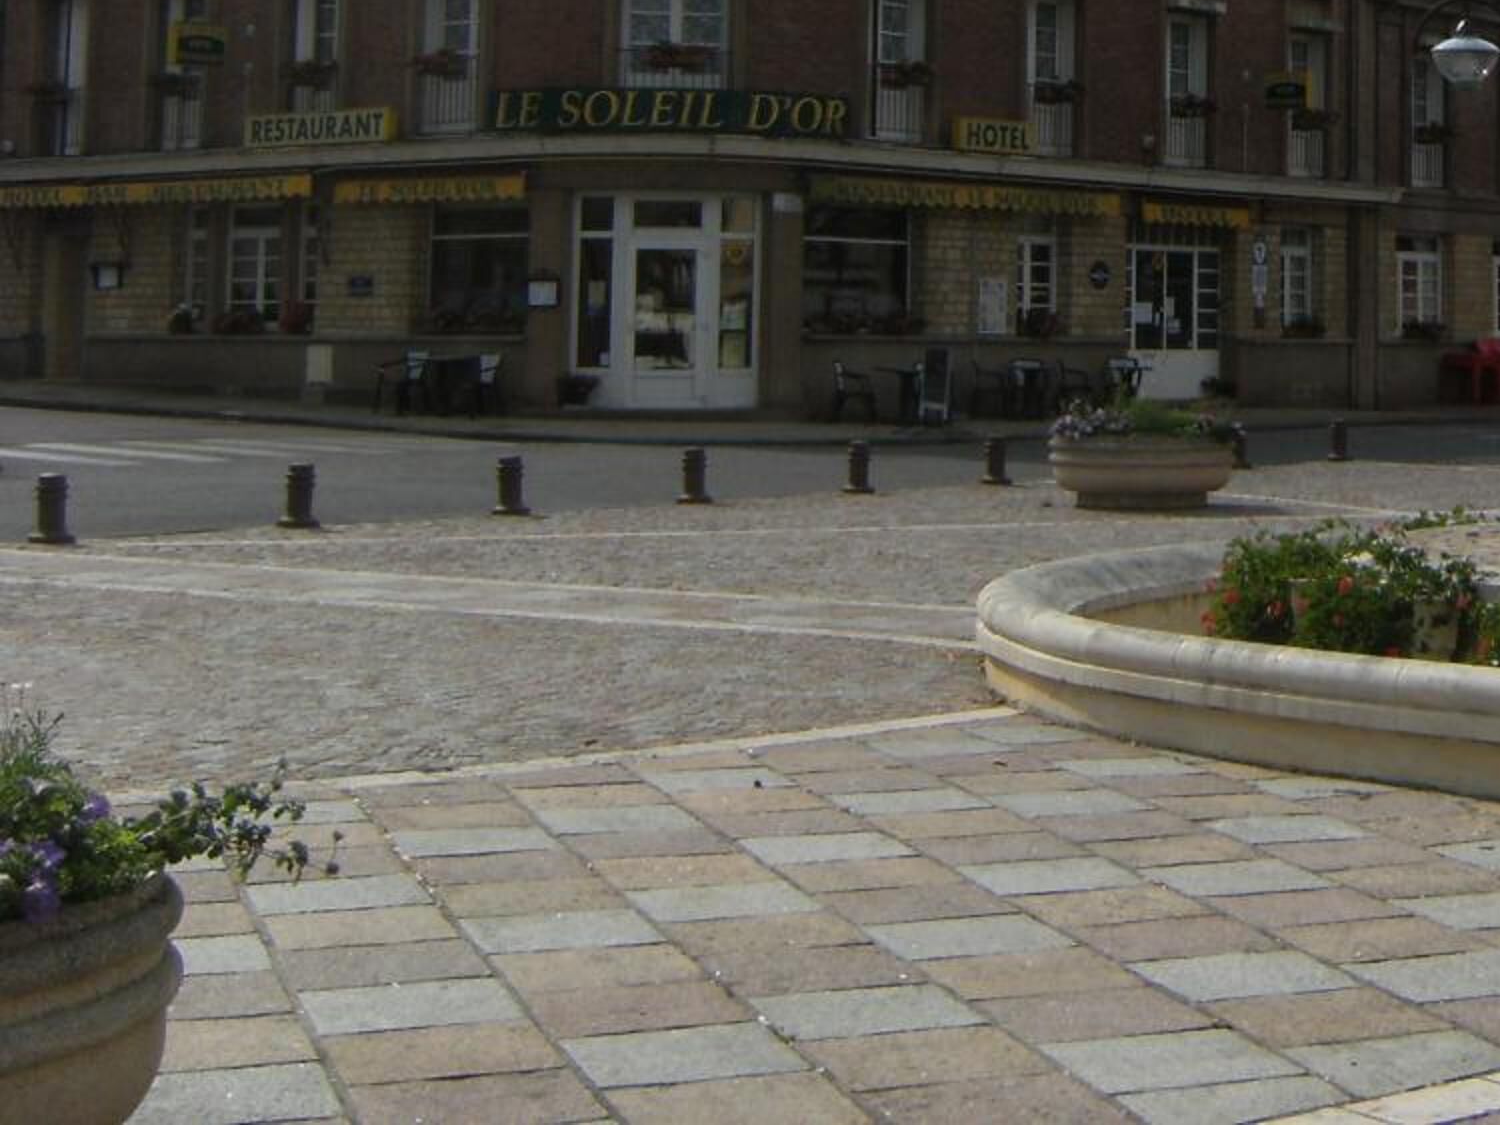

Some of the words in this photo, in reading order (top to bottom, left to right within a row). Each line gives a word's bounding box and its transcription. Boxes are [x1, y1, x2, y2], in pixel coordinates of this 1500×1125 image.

[250, 110, 384, 145] RESTAURANT
[495, 91, 544, 129] LE
[557, 89, 722, 129] SOLEIL
[747, 92, 849, 134] D'OR
[966, 121, 1030, 151] HOTEL
